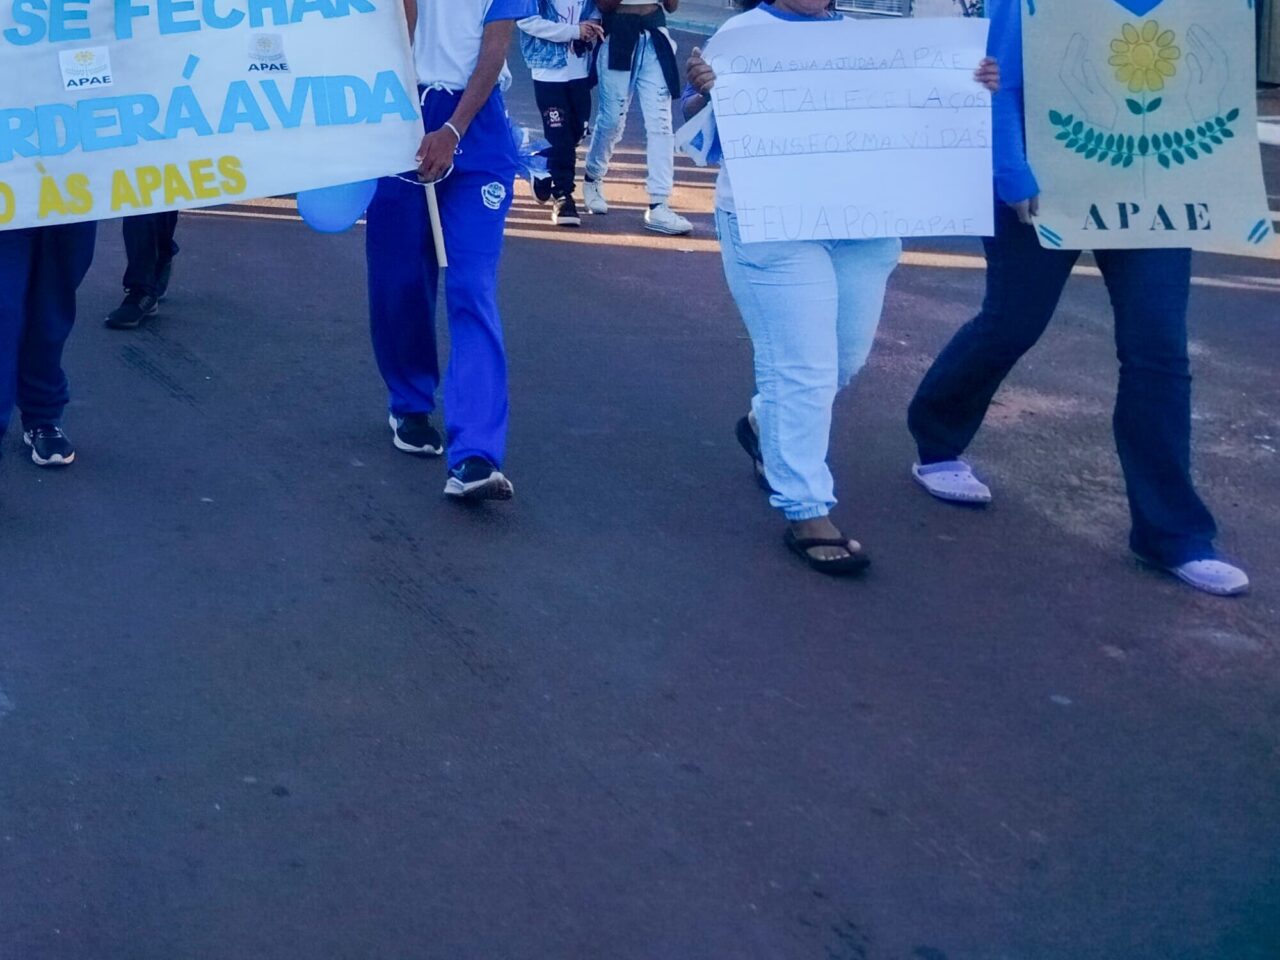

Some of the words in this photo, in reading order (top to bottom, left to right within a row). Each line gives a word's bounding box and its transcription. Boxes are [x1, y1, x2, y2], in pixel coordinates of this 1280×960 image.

[248, 62, 289, 72] APAE
[890, 47, 961, 68] APAE
[67, 76, 112, 88] APAE
[35, 161, 93, 220] ÀS
[111, 156, 247, 210] APAES
[1082, 202, 1211, 231] APAE
